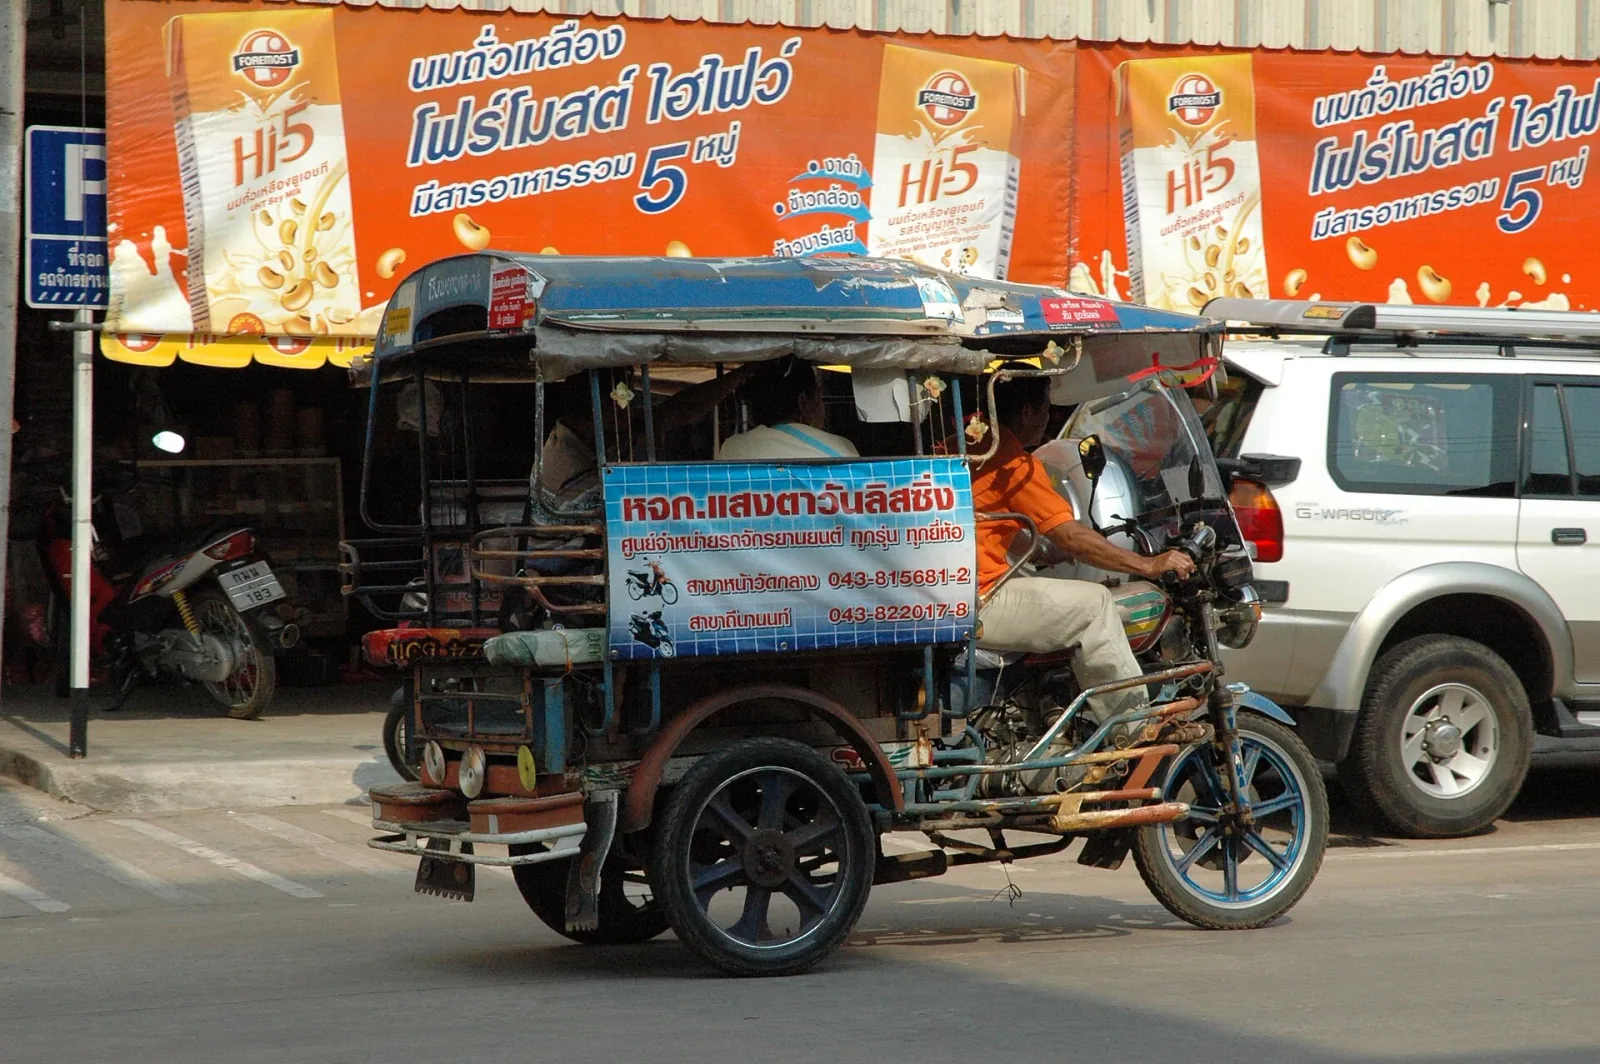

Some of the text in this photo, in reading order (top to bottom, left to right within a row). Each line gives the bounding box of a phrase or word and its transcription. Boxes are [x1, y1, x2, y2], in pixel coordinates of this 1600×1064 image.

[238, 54, 294, 66] FOREMOST
[411, 23, 625, 89] นมถั่วเหลือง
[408, 39, 800, 165] โฟร์โมสต์ ไฮไฟว์
[923, 92, 971, 108] FOREMOST
[1173, 95, 1216, 107] FOREMOST
[1314, 62, 1491, 126] นมถั่วเหลือง
[234, 102, 315, 187] Hi-5
[825, 155, 862, 176] งาดำ
[1311, 101, 1501, 193] โฟร์โมสต์
[65, 144, 107, 221] P
[411, 124, 739, 215] มีสารอาหารรวม 5 หมู่
[898, 143, 979, 208] Hi-5
[1166, 137, 1236, 215] Hi-5
[1313, 148, 1588, 239] มีสารอาหารรวม 5 หมู่
[790, 186, 860, 211] ข้าวกล้อง
[68, 241, 105, 267] ที่จอด
[623, 474, 956, 522] หจก.แสงตาวันลิสซิ่ง
[621, 518, 964, 559] ศูนย์จำหน่ายรถจักรยานยนต์ ทุกรุ่น ทุกยี่ห้อ
[246, 588, 272, 604] 183
[686, 567, 971, 596] สาขาหน้าวัดกลาง 043-815681-2
[828, 602, 969, 624] 043-822017-8
